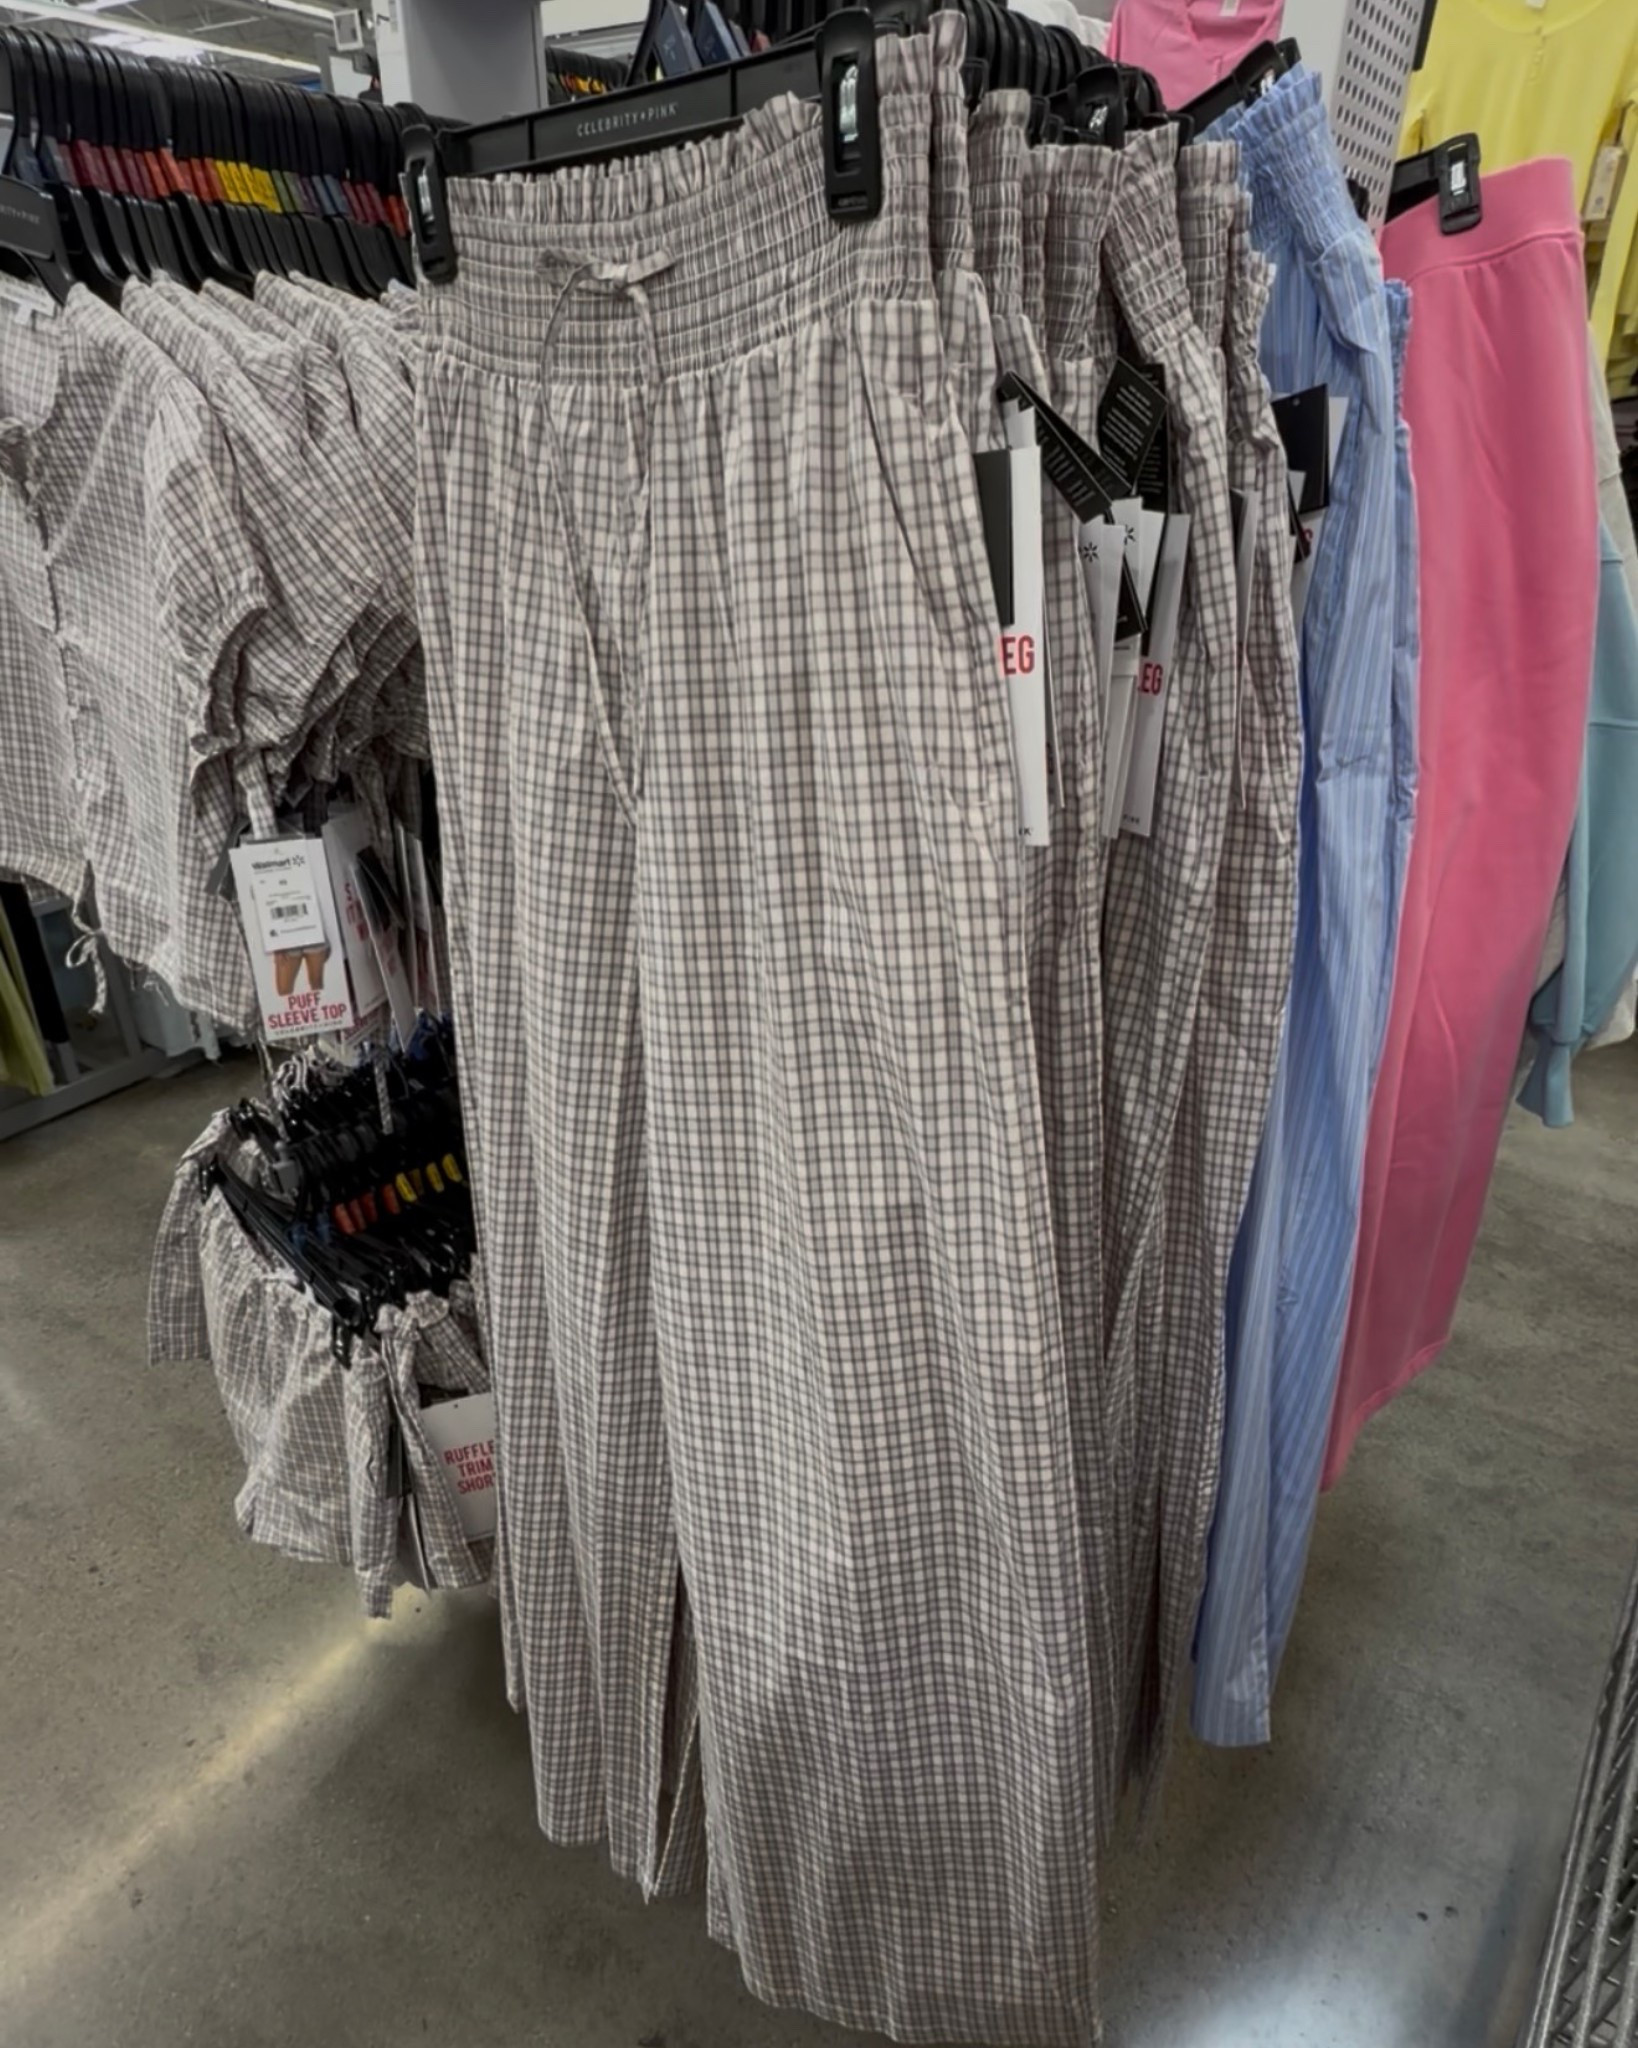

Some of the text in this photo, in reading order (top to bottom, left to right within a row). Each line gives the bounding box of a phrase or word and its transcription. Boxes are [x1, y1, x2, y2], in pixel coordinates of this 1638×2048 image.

[1138, 663, 1163, 696] EG
[288, 992, 320, 1010] PUFF
[268, 1009, 318, 1029] SLEEVE
[321, 1003, 347, 1020] TOP
[444, 1439, 494, 1465] RUFFLE
[457, 1457, 494, 1477] TRIM
